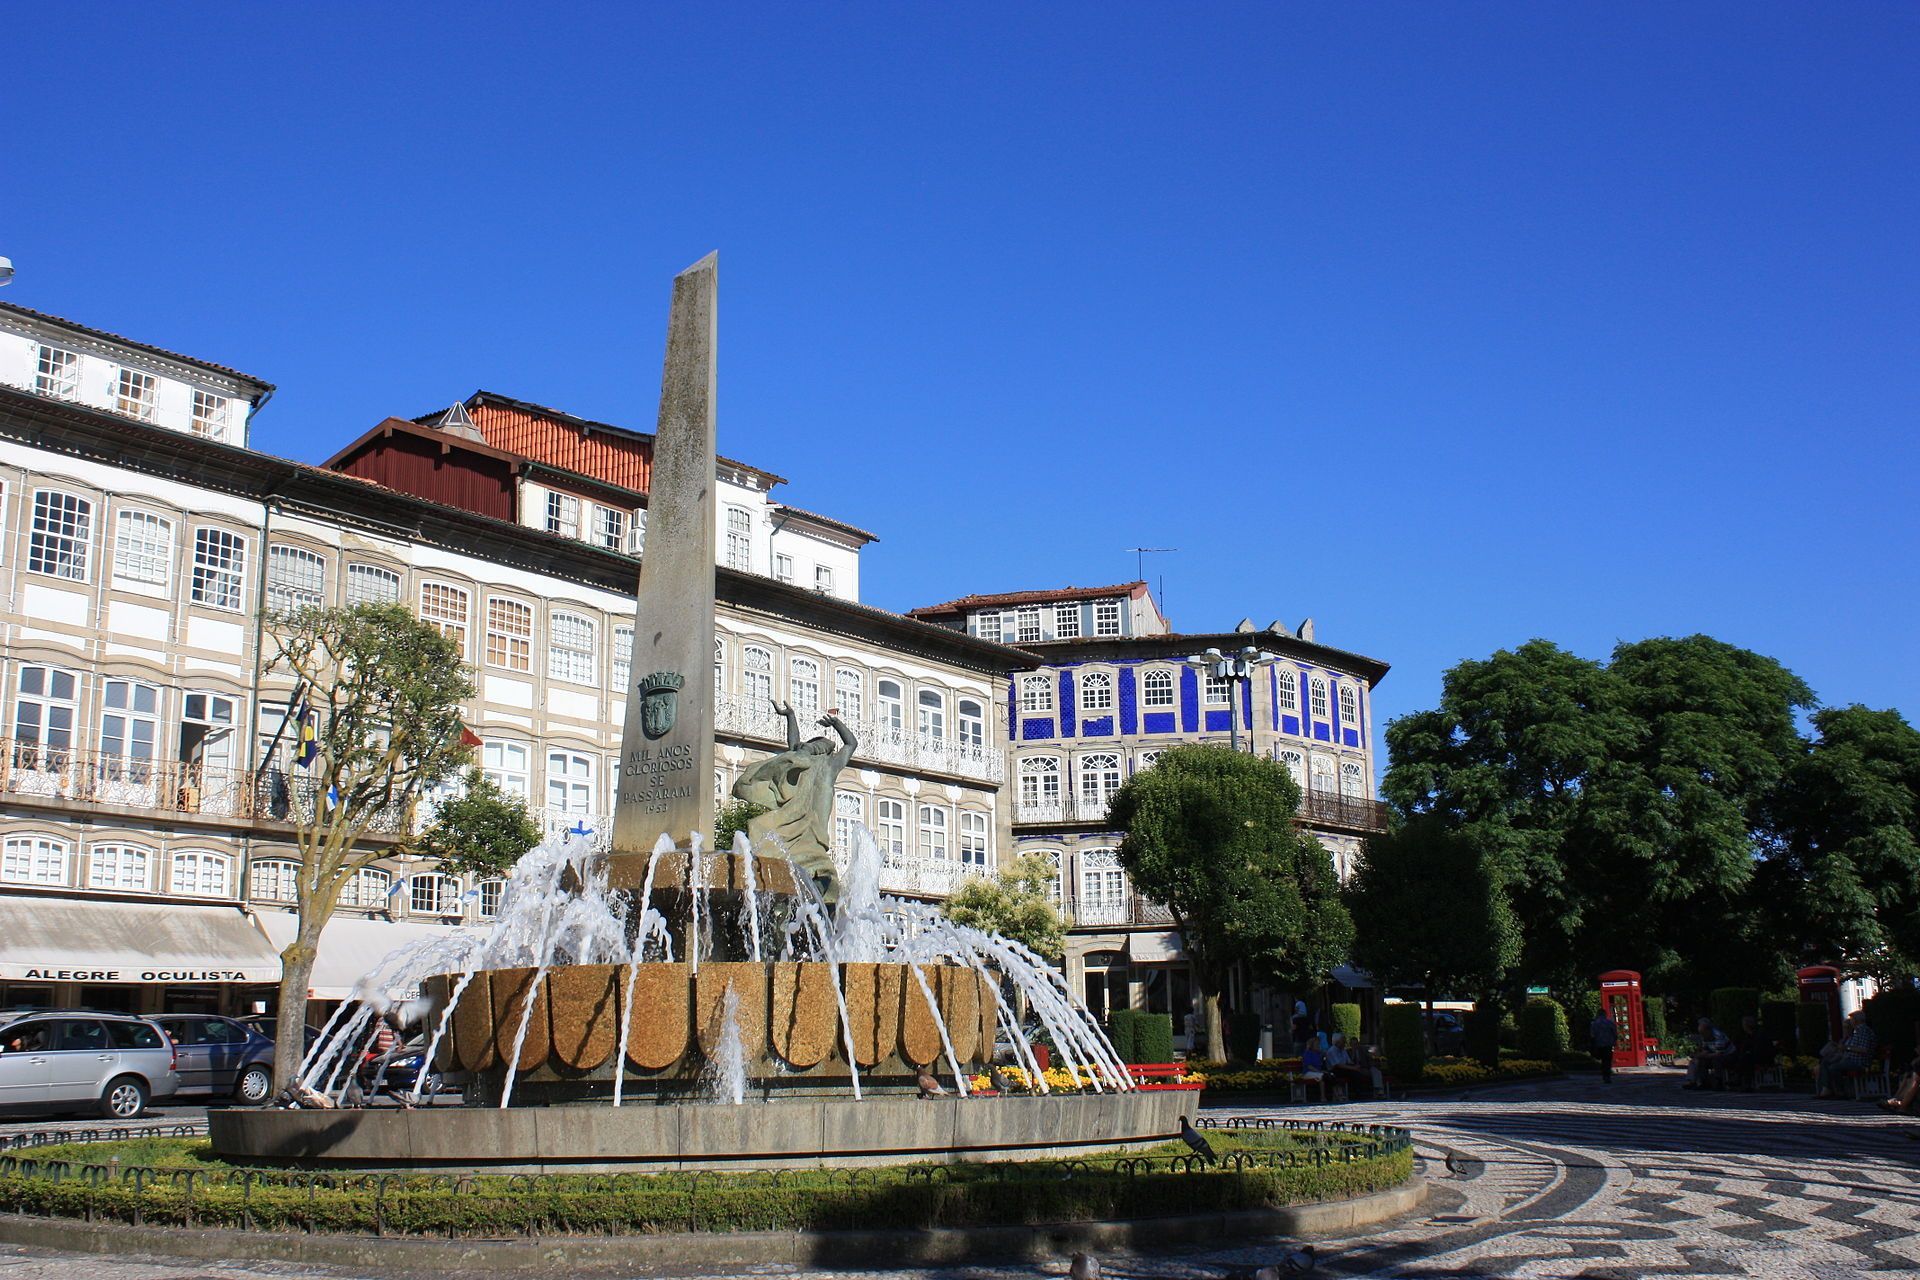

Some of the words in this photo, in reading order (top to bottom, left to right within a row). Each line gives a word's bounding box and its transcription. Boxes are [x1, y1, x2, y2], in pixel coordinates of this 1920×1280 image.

[630, 750, 652, 762] MIL
[657, 745, 691, 759] ANOS
[626, 758, 692, 776] GLORIOSOS
[650, 776, 664, 787] SE
[624, 786, 691, 804] PASSARAM
[645, 804, 667, 814] 1953
[26, 969, 119, 980] ALEGRE
[141, 971, 246, 980] OCULISTA
